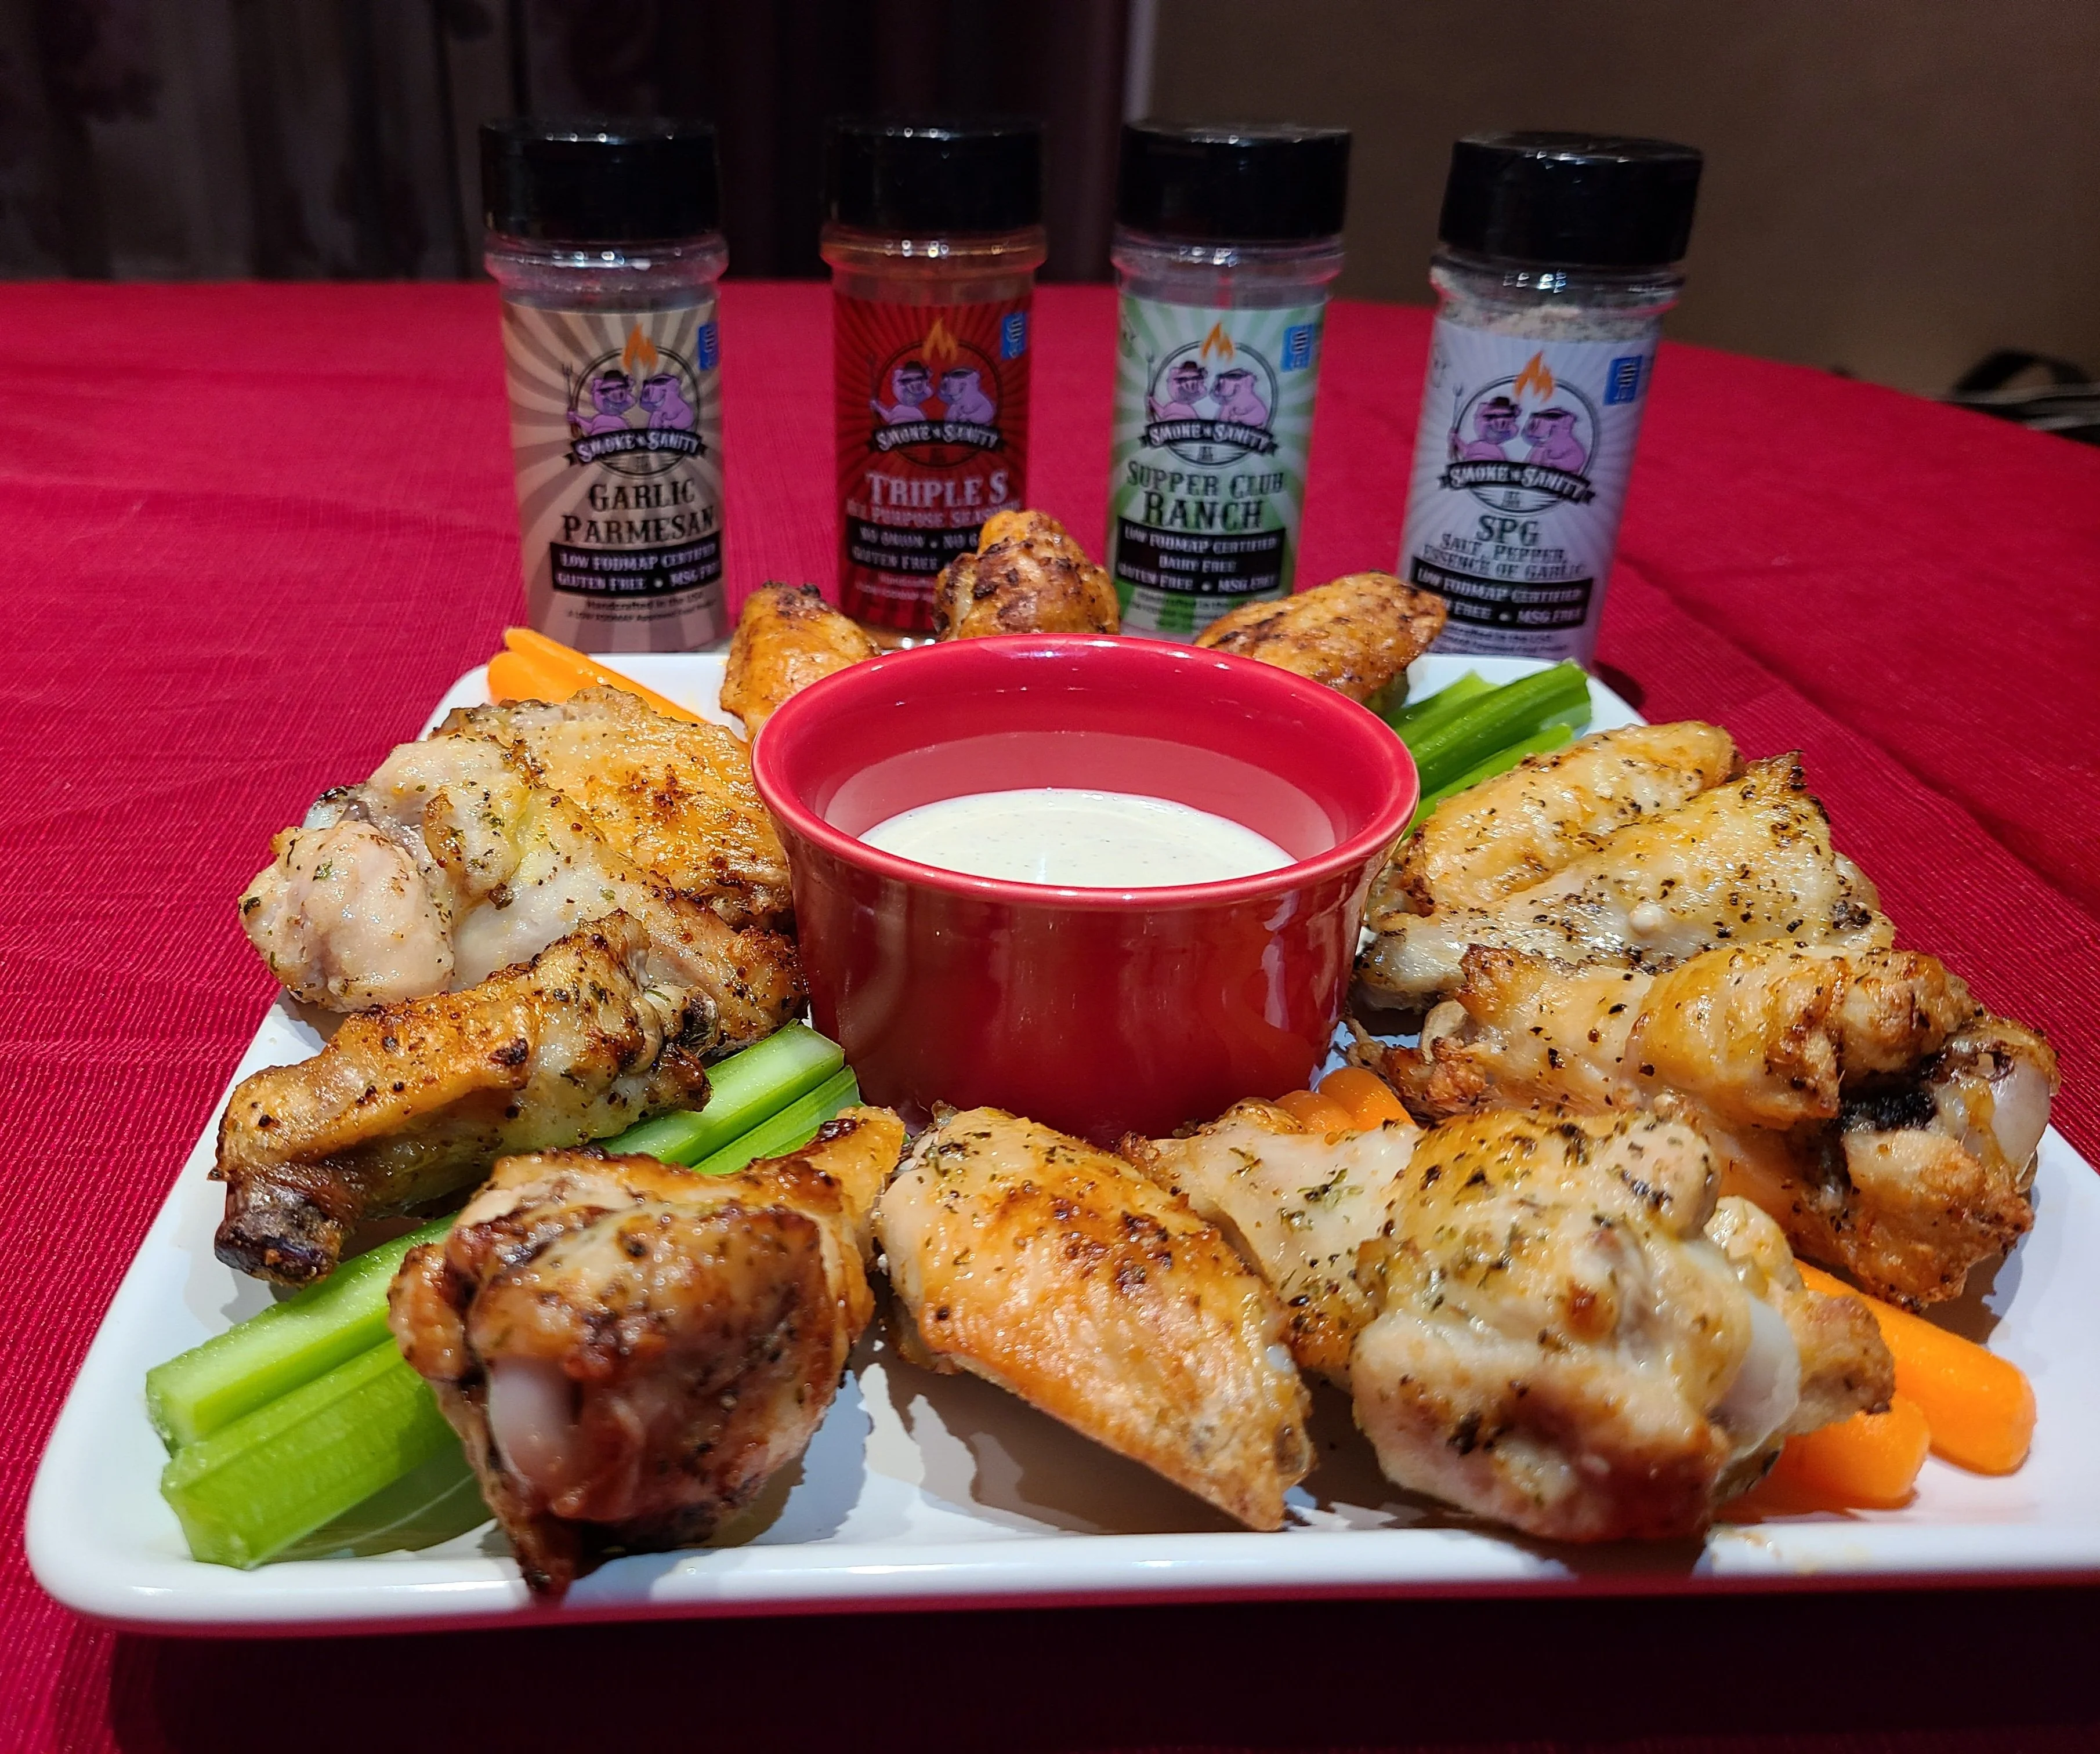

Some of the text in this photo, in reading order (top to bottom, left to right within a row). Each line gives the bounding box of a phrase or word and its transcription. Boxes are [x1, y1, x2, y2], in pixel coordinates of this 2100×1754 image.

[588, 479, 695, 512] GARLIC
[864, 469, 1009, 508] TRIPLE S
[1128, 461, 1284, 499] SUPPER CLUB
[561, 505, 714, 542] PARMESAN
[1143, 491, 1263, 530] RANCH
[1476, 515, 1540, 546] SPG
